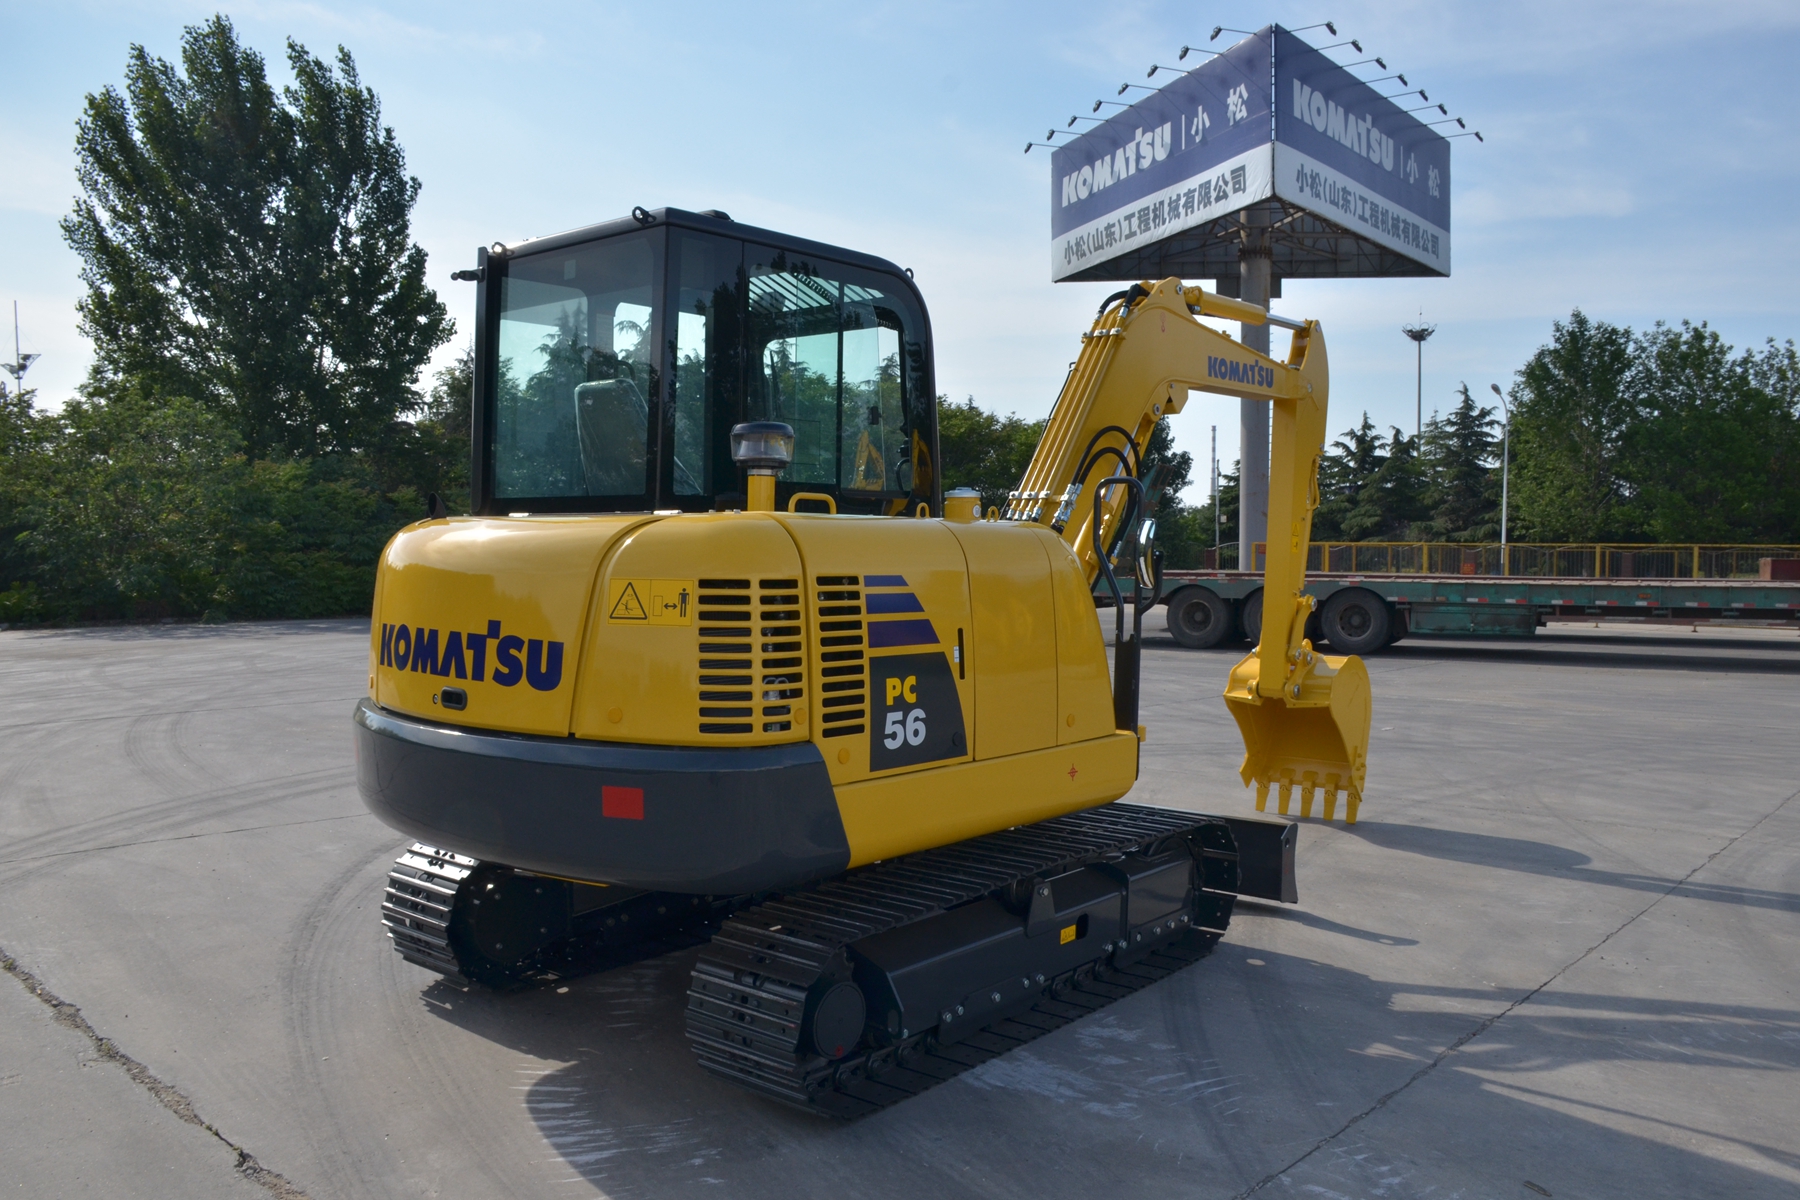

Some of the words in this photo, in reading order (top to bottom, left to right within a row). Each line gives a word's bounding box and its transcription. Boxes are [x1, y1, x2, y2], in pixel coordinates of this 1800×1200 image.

[1061, 121, 1172, 208] KOMATSU
[1290, 78, 1394, 172] KOMATSU
[1064, 164, 1247, 266] 小松(山东)工程机械有限公司
[1296, 163, 1440, 259] 小松(山东)工程机械有限公司
[1207, 355, 1274, 389] KOMATSU
[379, 619, 565, 692] KOMATSU
[885, 675, 917, 706] PC
[883, 708, 927, 750] 56
